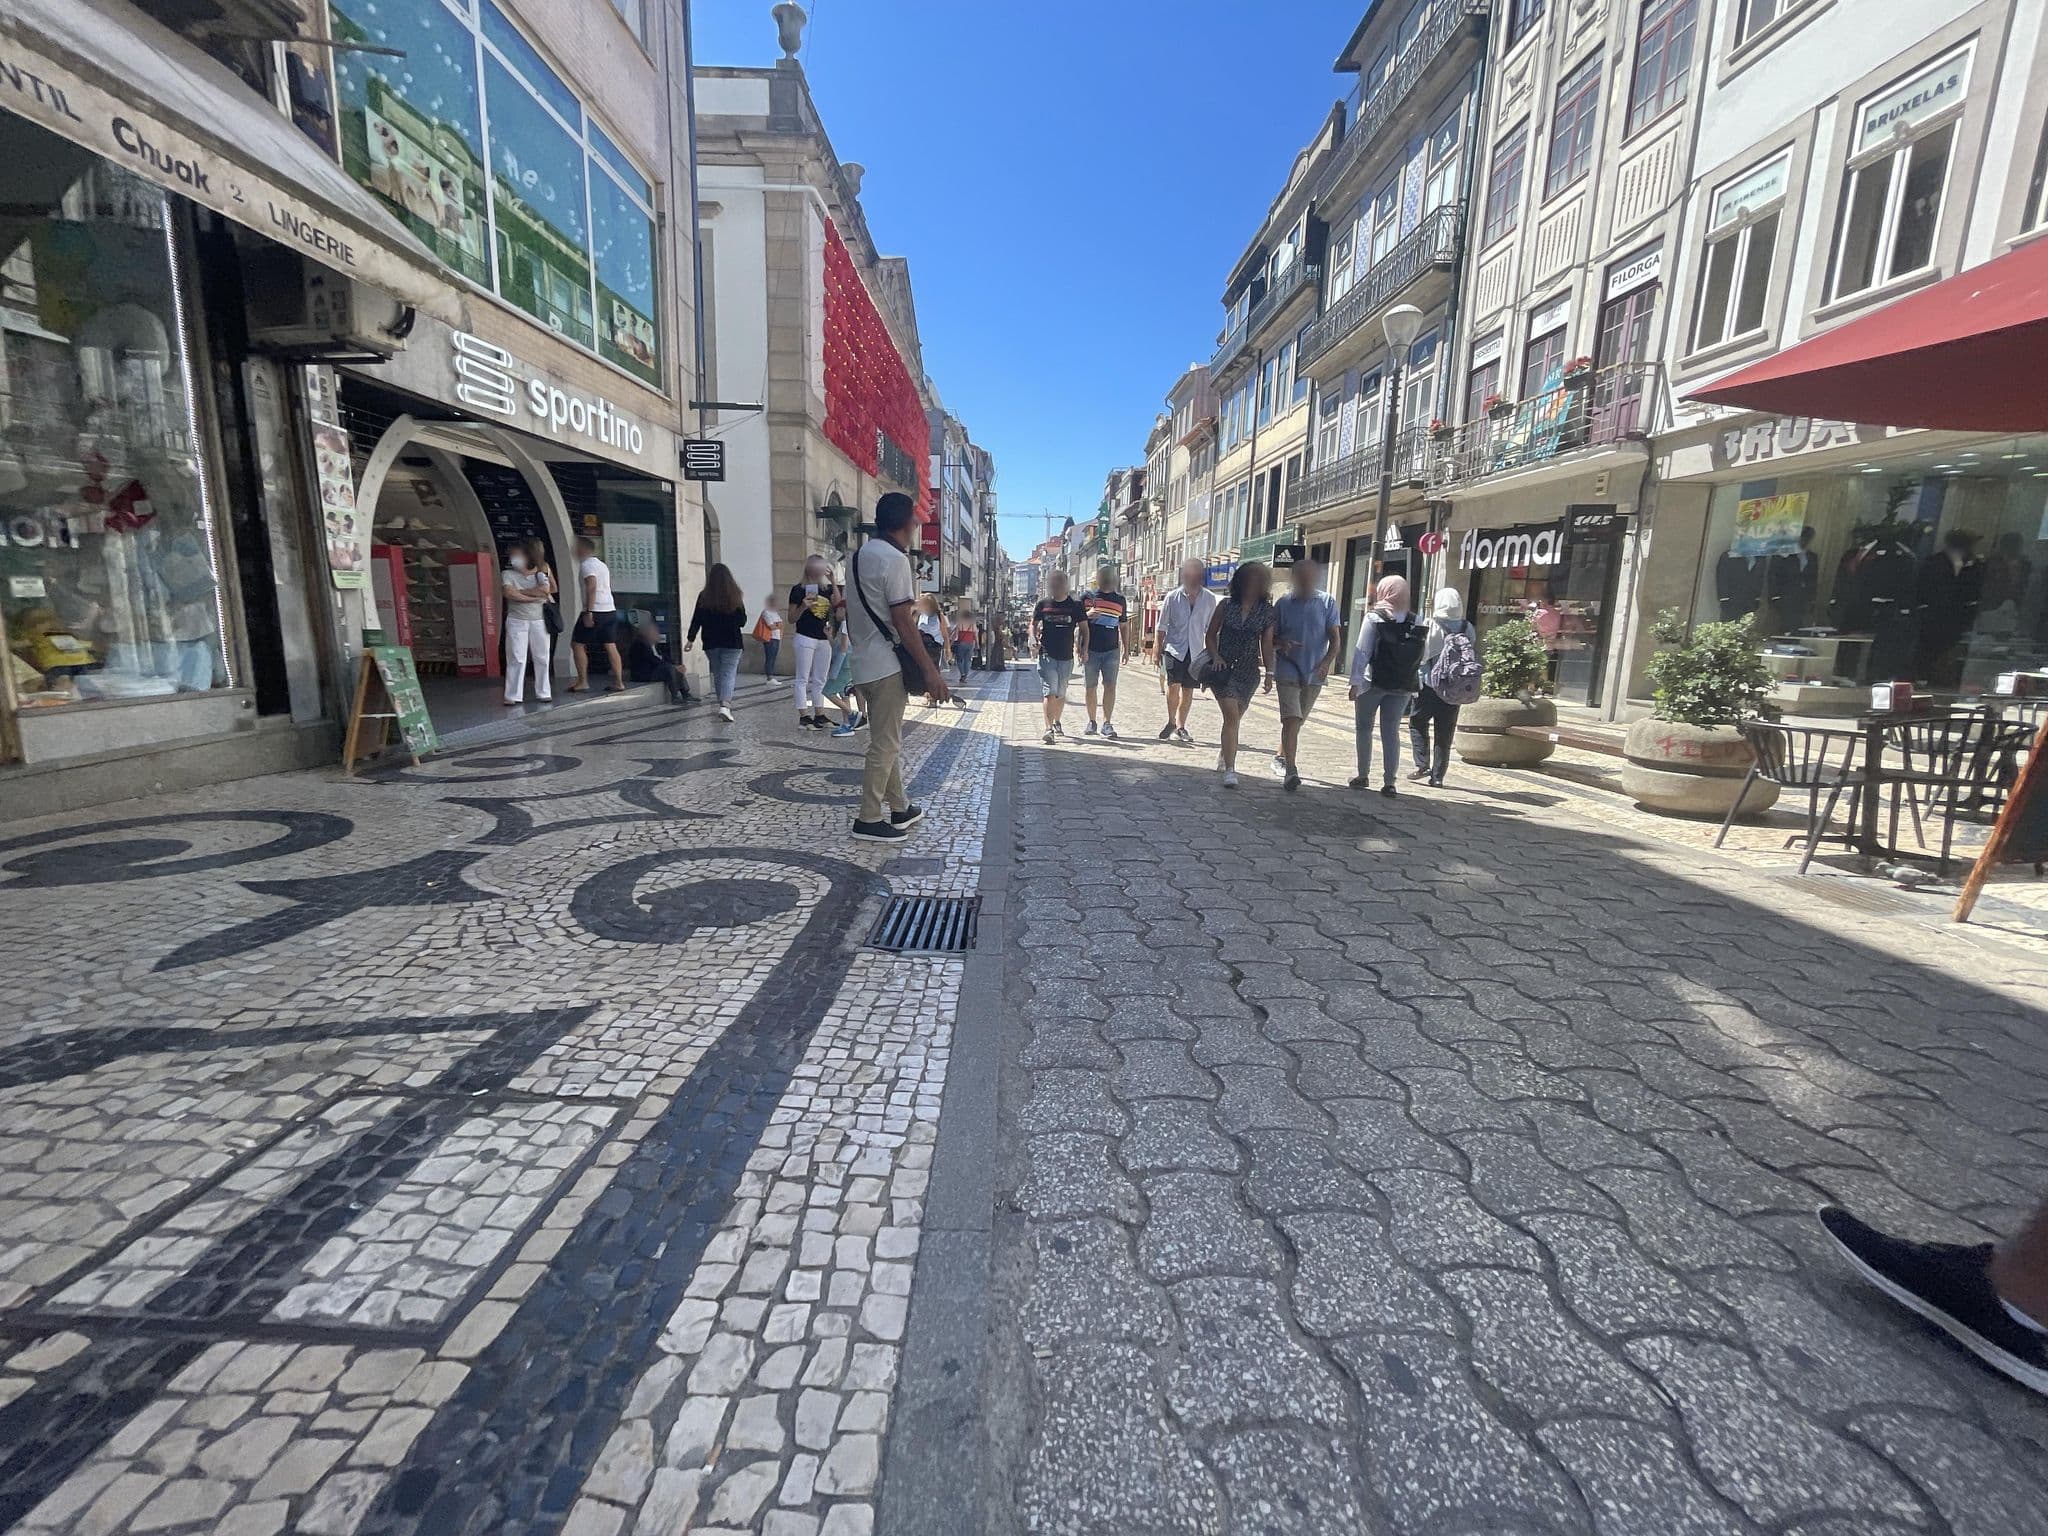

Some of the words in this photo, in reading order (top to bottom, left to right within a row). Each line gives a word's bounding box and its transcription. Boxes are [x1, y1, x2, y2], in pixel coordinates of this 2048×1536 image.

[1866, 73, 1960, 133] BRUXELAS
[112, 116, 210, 194] Chuak
[229, 183, 245, 203] 2
[267, 200, 356, 267] LINGERIE
[1611, 252, 1660, 288] FILORGA
[528, 378, 643, 455] sportino
